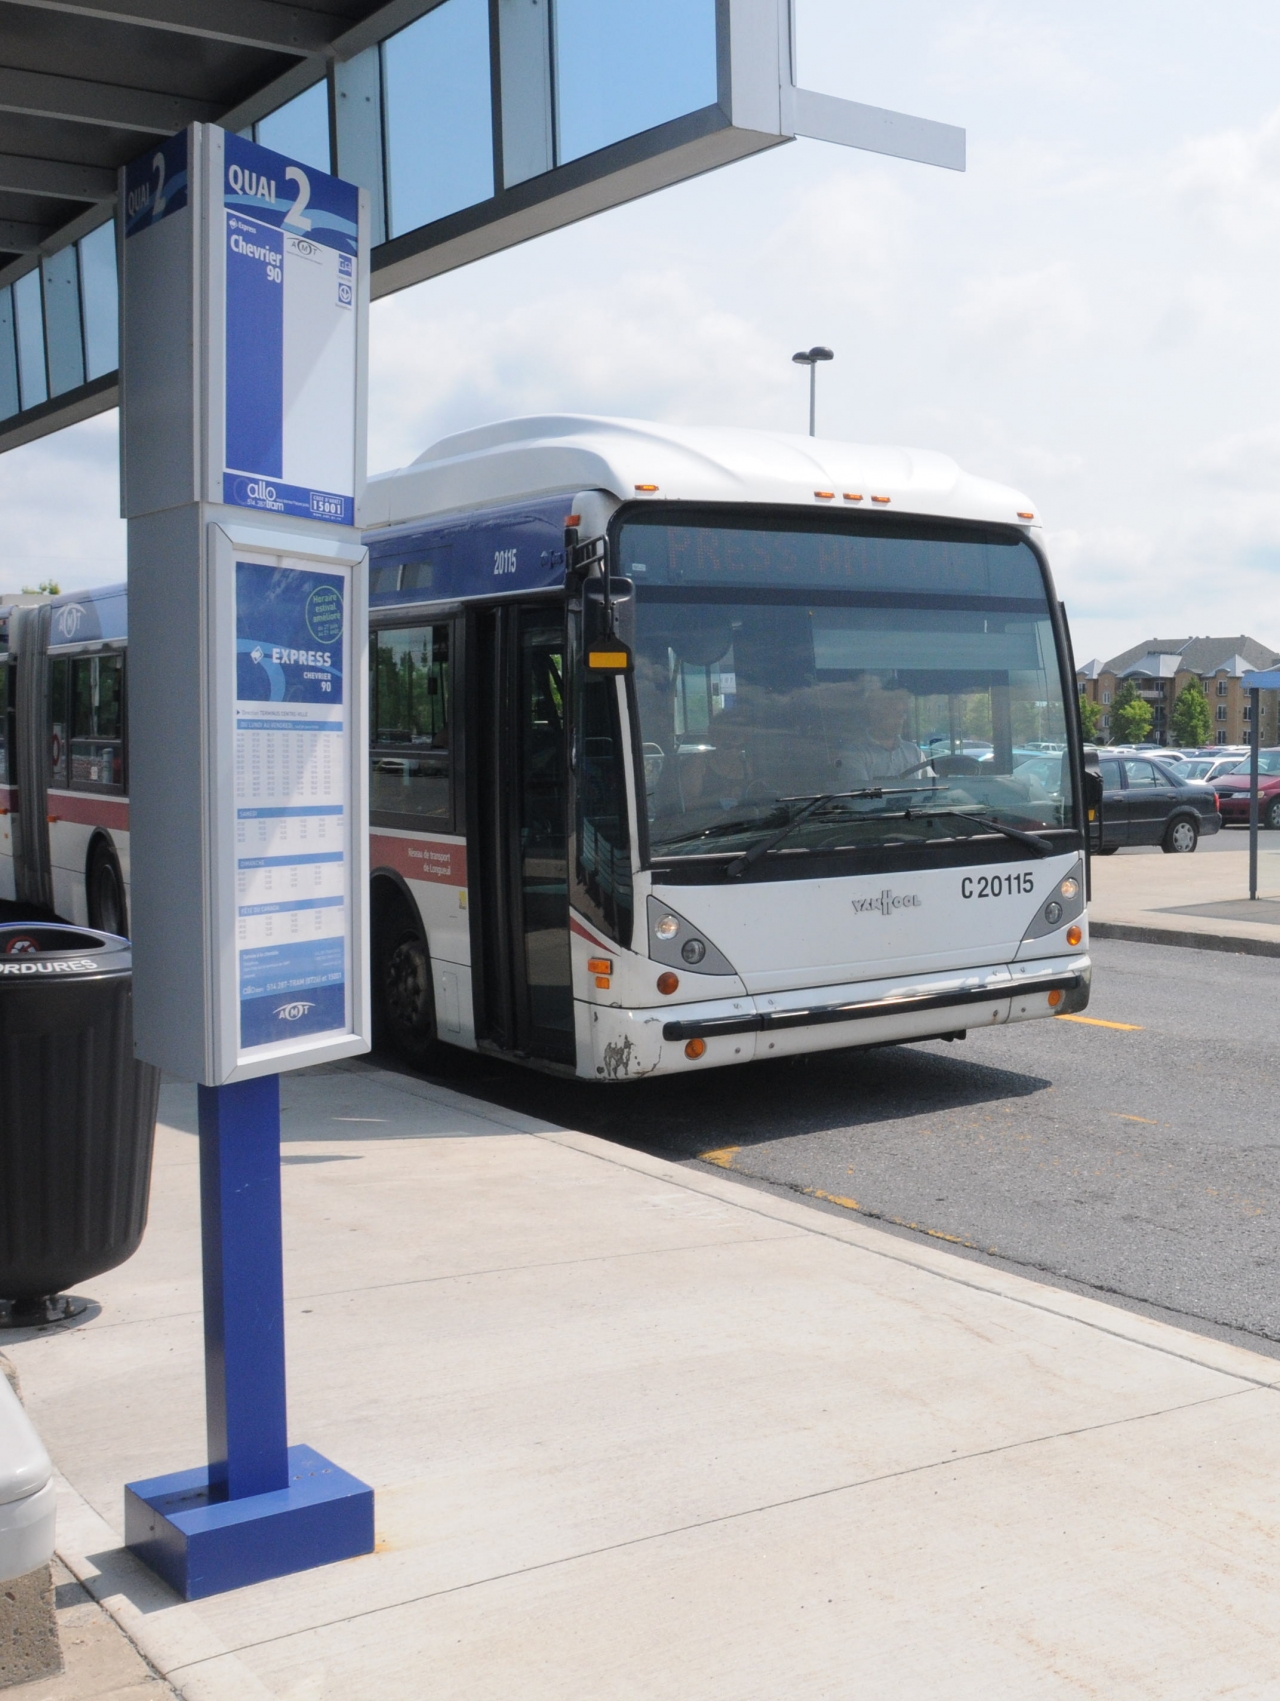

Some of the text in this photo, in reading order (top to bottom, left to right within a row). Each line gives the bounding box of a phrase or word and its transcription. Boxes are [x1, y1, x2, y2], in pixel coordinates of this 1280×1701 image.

[128, 152, 166, 216] QUAI 2
[228, 164, 312, 231] QUAI 2
[230, 234, 282, 267] Chevrier
[266, 265, 282, 283] 90
[247, 481, 276, 501] allo
[313, 500, 341, 514] 15001
[494, 548, 517, 575] 20115
[313, 593, 337, 604] Horaire
[315, 602, 336, 613] estival
[272, 648, 332, 667] EXPRESS
[303, 672, 331, 680] CHEVRIER
[321, 682, 331, 692] 90
[239, 810, 257, 818] SAMEDI
[0, 959, 98, 974] RDURES
